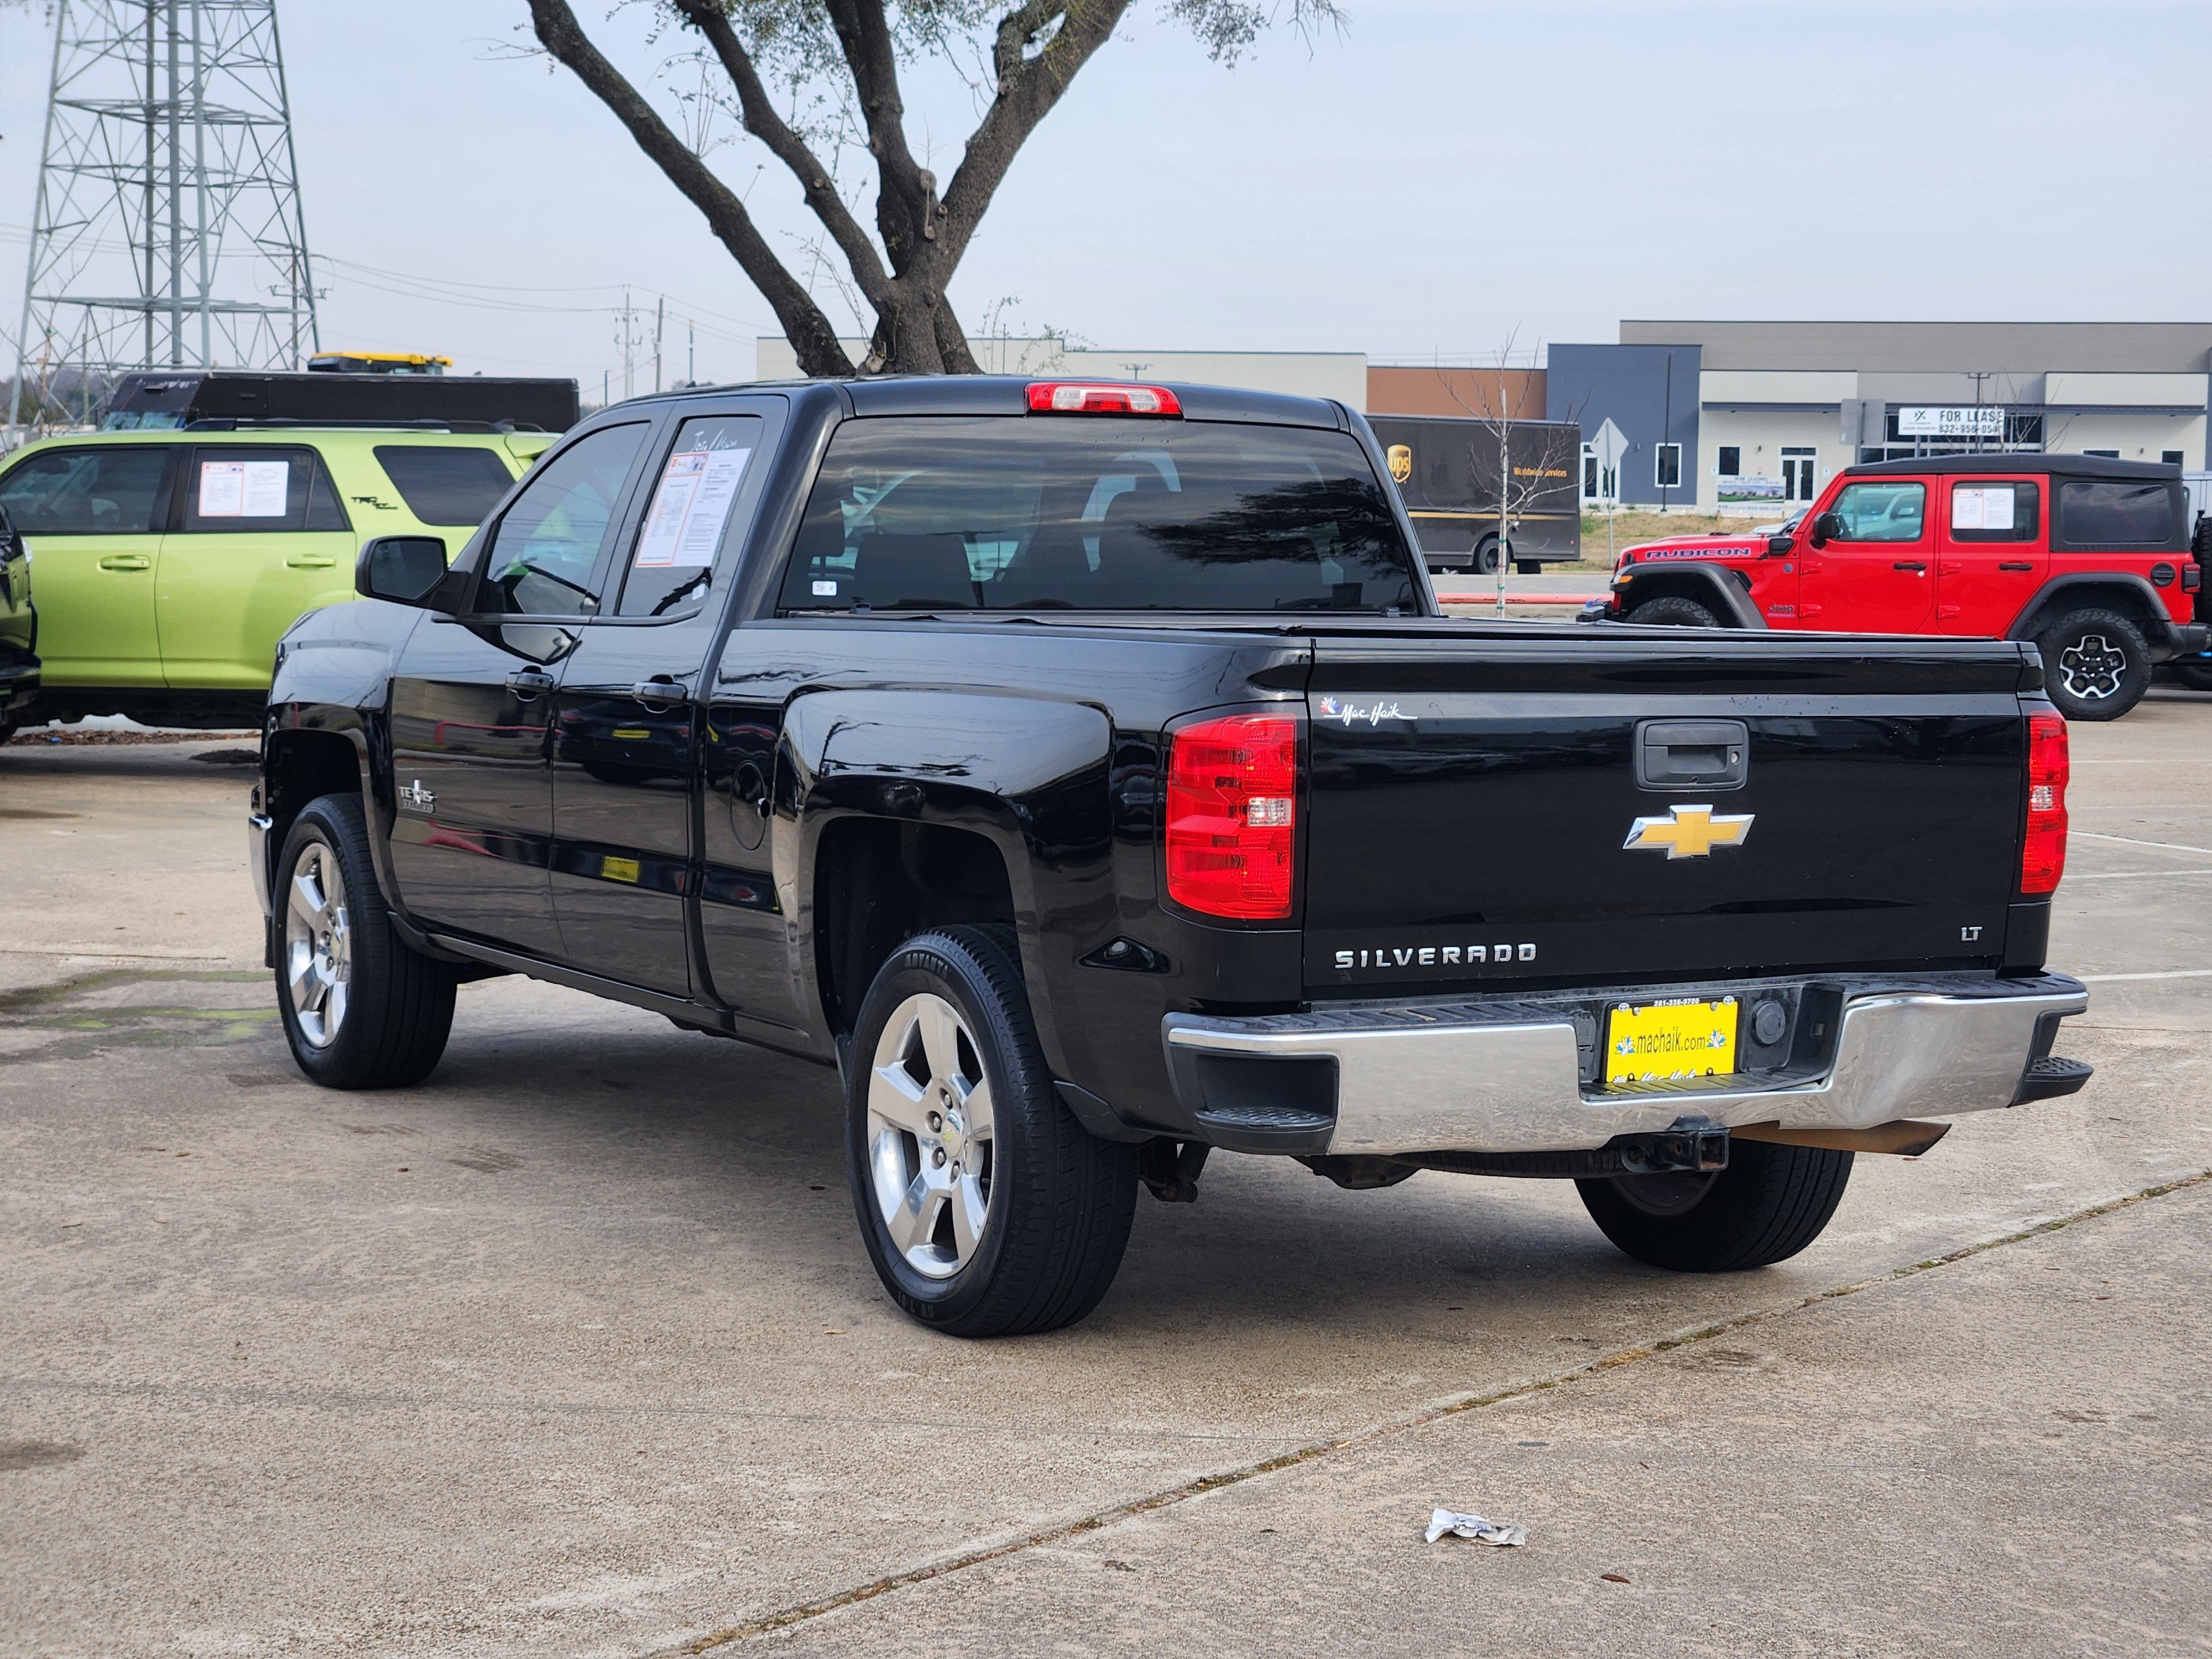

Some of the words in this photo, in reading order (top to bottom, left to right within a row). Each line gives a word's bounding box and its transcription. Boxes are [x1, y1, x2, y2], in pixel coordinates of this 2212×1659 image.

[1940, 410, 1961, 422] FOR
[1968, 410, 2004, 422] LEASE
[1389, 456, 1408, 477] ups
[1645, 547, 1751, 560] RUBICON
[1768, 602, 1794, 614] Jeep
[1335, 704, 1370, 727] Mac
[1369, 701, 1409, 727] Haik
[1961, 926, 1983, 941] LT
[1334, 943, 1537, 969] SILVERADO
[1636, 1026, 1705, 1055] machaik.com
